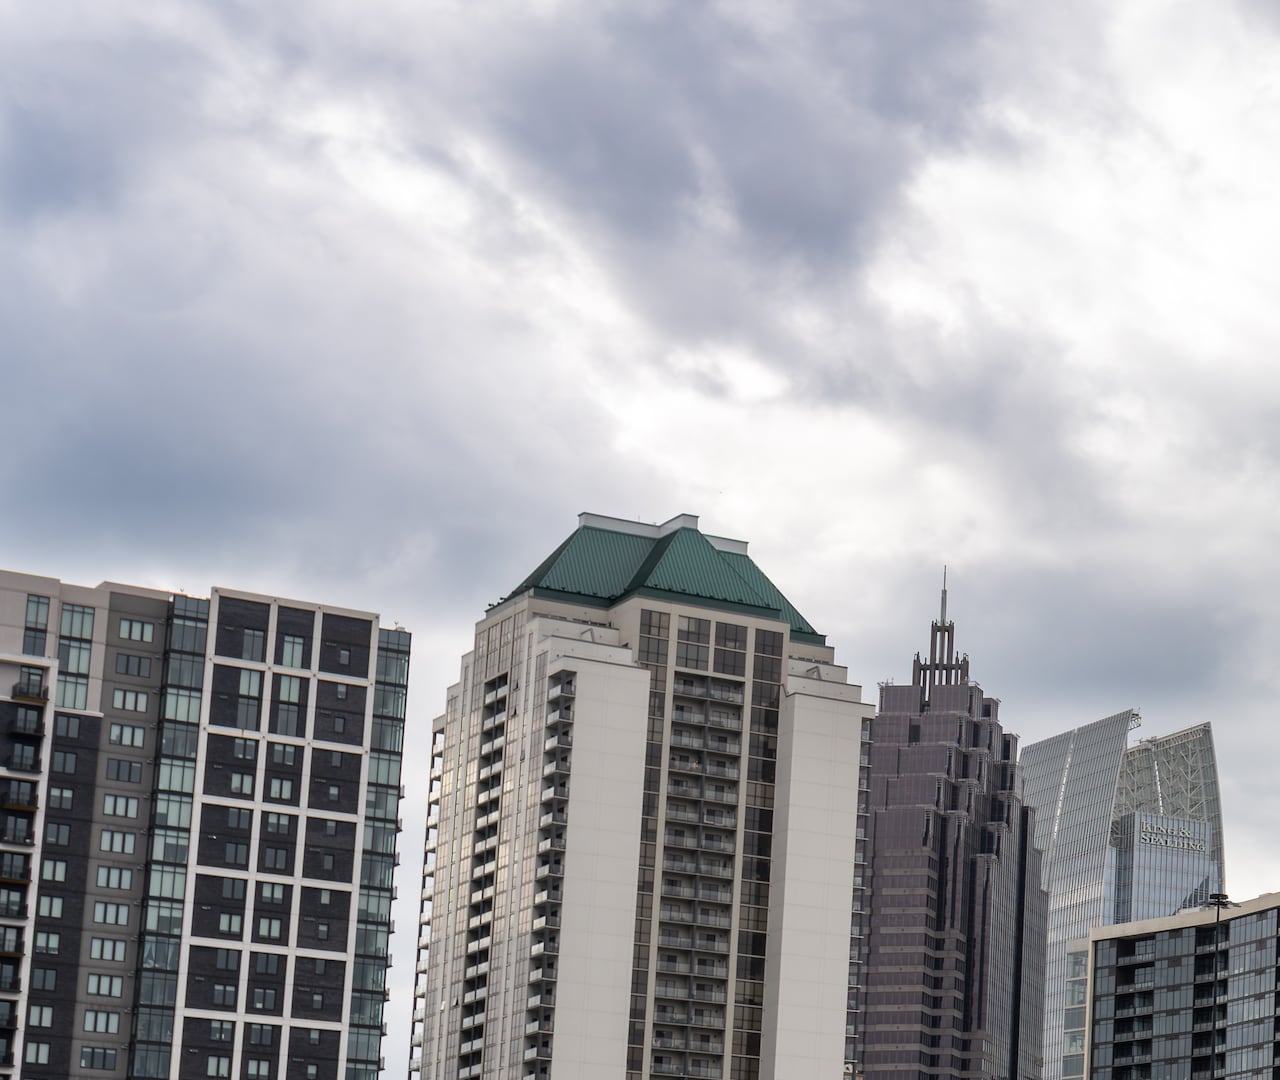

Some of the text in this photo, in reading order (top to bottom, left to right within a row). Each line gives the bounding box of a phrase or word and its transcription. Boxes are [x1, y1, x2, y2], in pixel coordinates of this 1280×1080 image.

[1142, 820, 1191, 838] KING &
[1141, 833, 1205, 851] SPALDING
